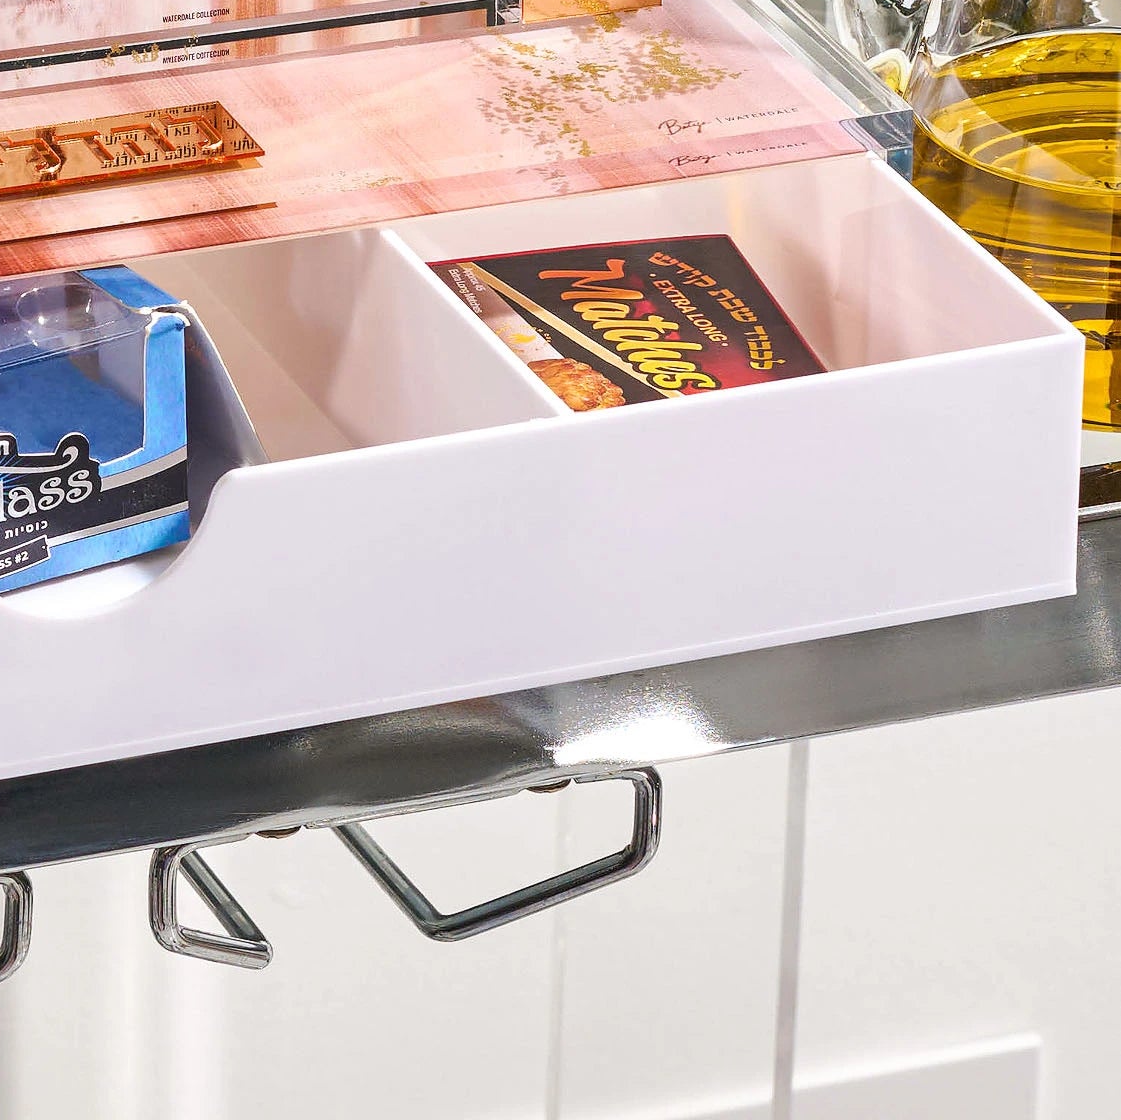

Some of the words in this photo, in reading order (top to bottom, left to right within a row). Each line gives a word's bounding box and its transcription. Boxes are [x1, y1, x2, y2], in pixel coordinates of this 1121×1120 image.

[162, 12, 195, 23] WATERDALE
[196, 8, 230, 19] COLLECTION
[725, 107, 800, 122] WATERDALE
[735, 142, 809, 155] WATERDALE
[652, 279, 692, 315] EXTRA
[687, 311, 728, 343] LONG
[708, 288, 758, 323] שבת
[539, 258, 721, 391] Matches
[3, 520, 50, 541] כוסיות
[14, 550, 29, 564] #2
